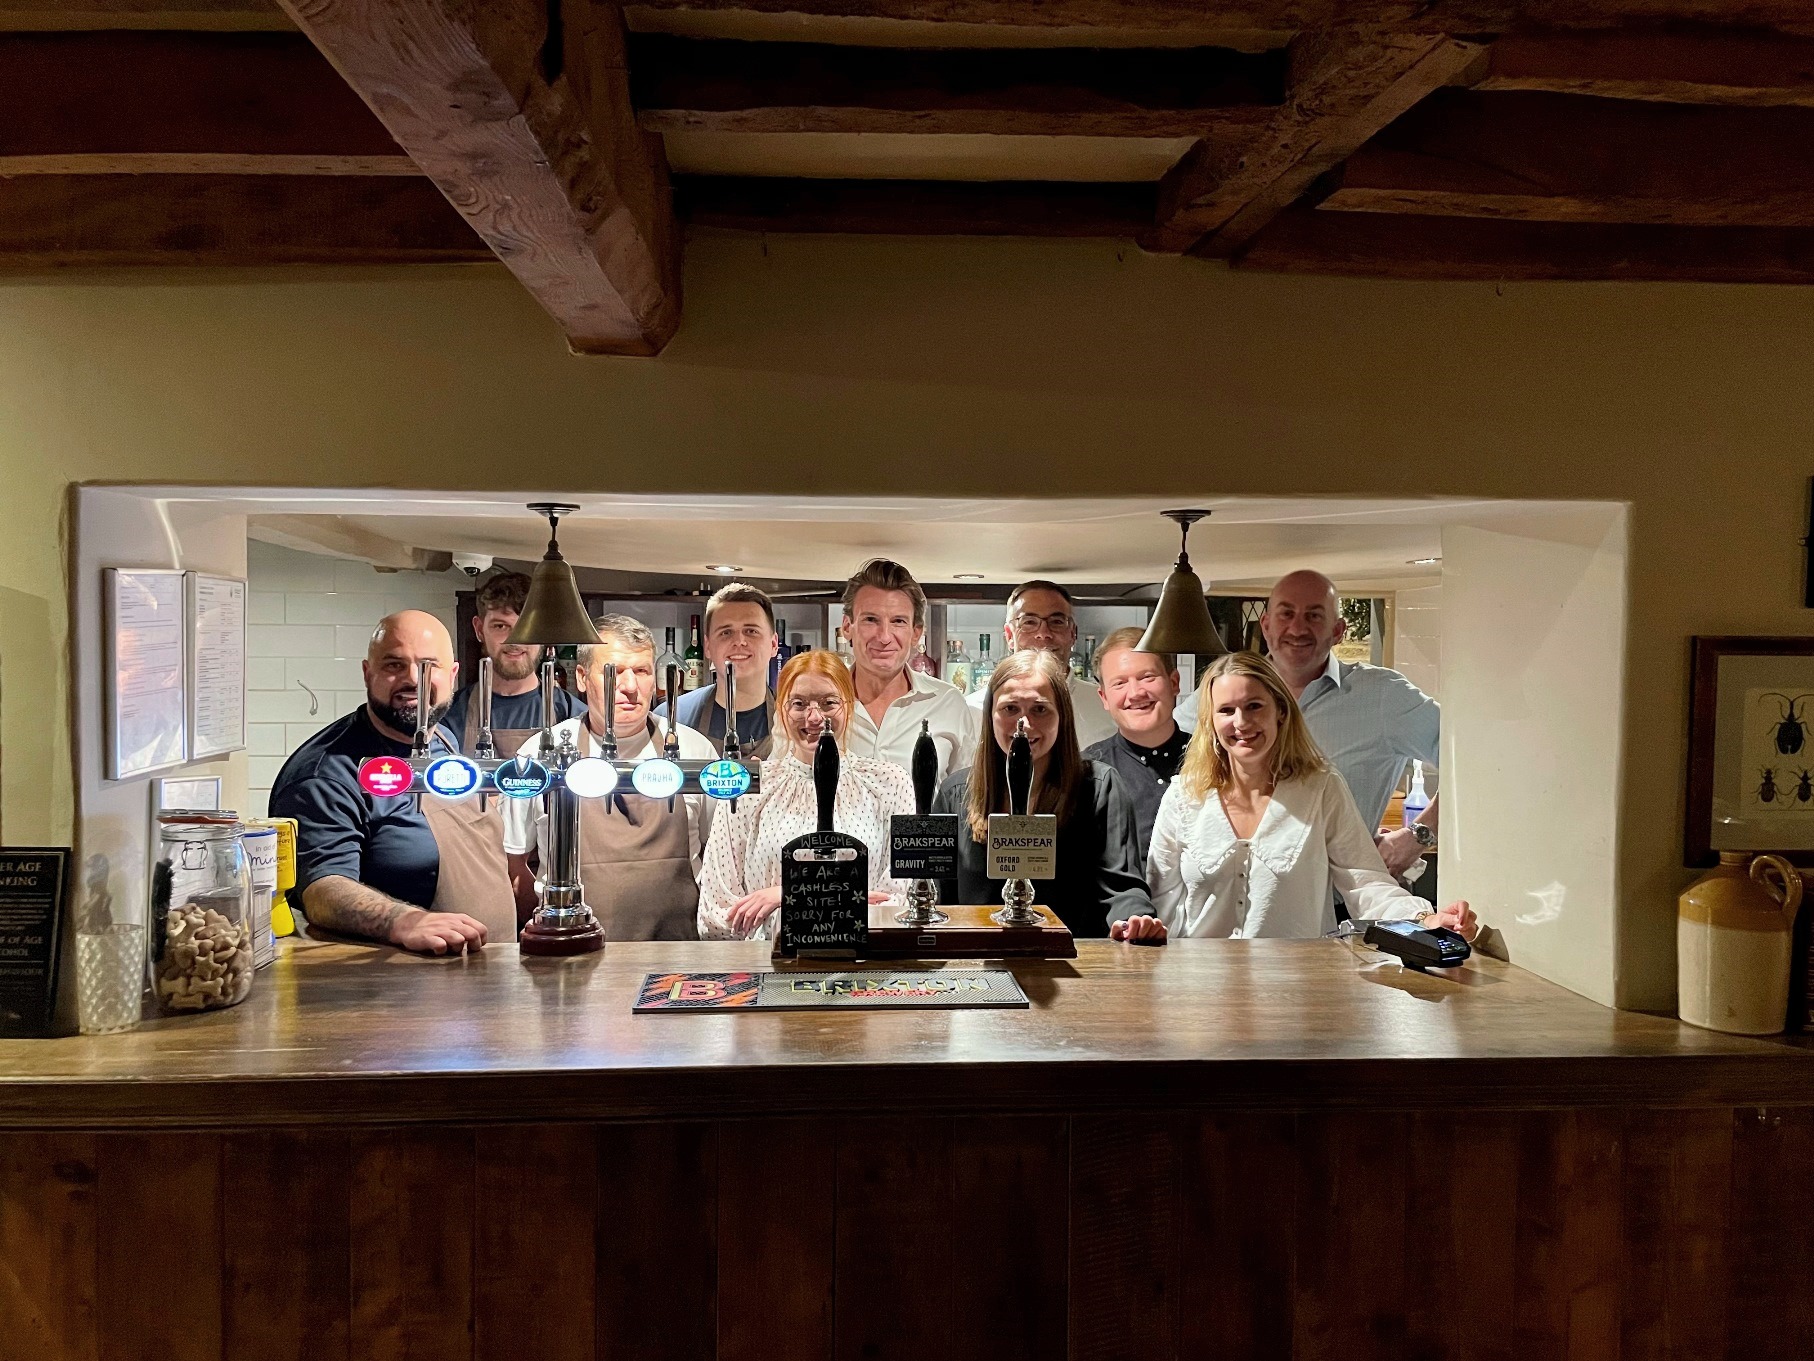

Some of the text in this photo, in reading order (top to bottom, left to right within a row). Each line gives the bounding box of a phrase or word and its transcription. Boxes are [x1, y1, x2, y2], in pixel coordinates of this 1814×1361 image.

[502, 777, 543, 787] GUINNESS
[707, 779, 743, 787] BRIXTON
[801, 834, 854, 849] WELCOME
[893, 837, 955, 850] BRAKSPEAR
[992, 837, 1053, 850] BRAKSPEAR
[895, 859, 925, 869] GRAVITY
[995, 856, 1020, 864] OXFORD
[16, 862, 42, 872] AGE
[999, 864, 1016, 872] GOLD
[790, 882, 850, 896] CASHLESS
[806, 893, 842, 907] SITE!
[785, 909, 855, 922] SORRY FOR
[811, 921, 835, 933] ANY
[785, 932, 868, 947] INCONVENIENCE
[668, 980, 727, 1001] B
[791, 978, 992, 996] BRIXTON
